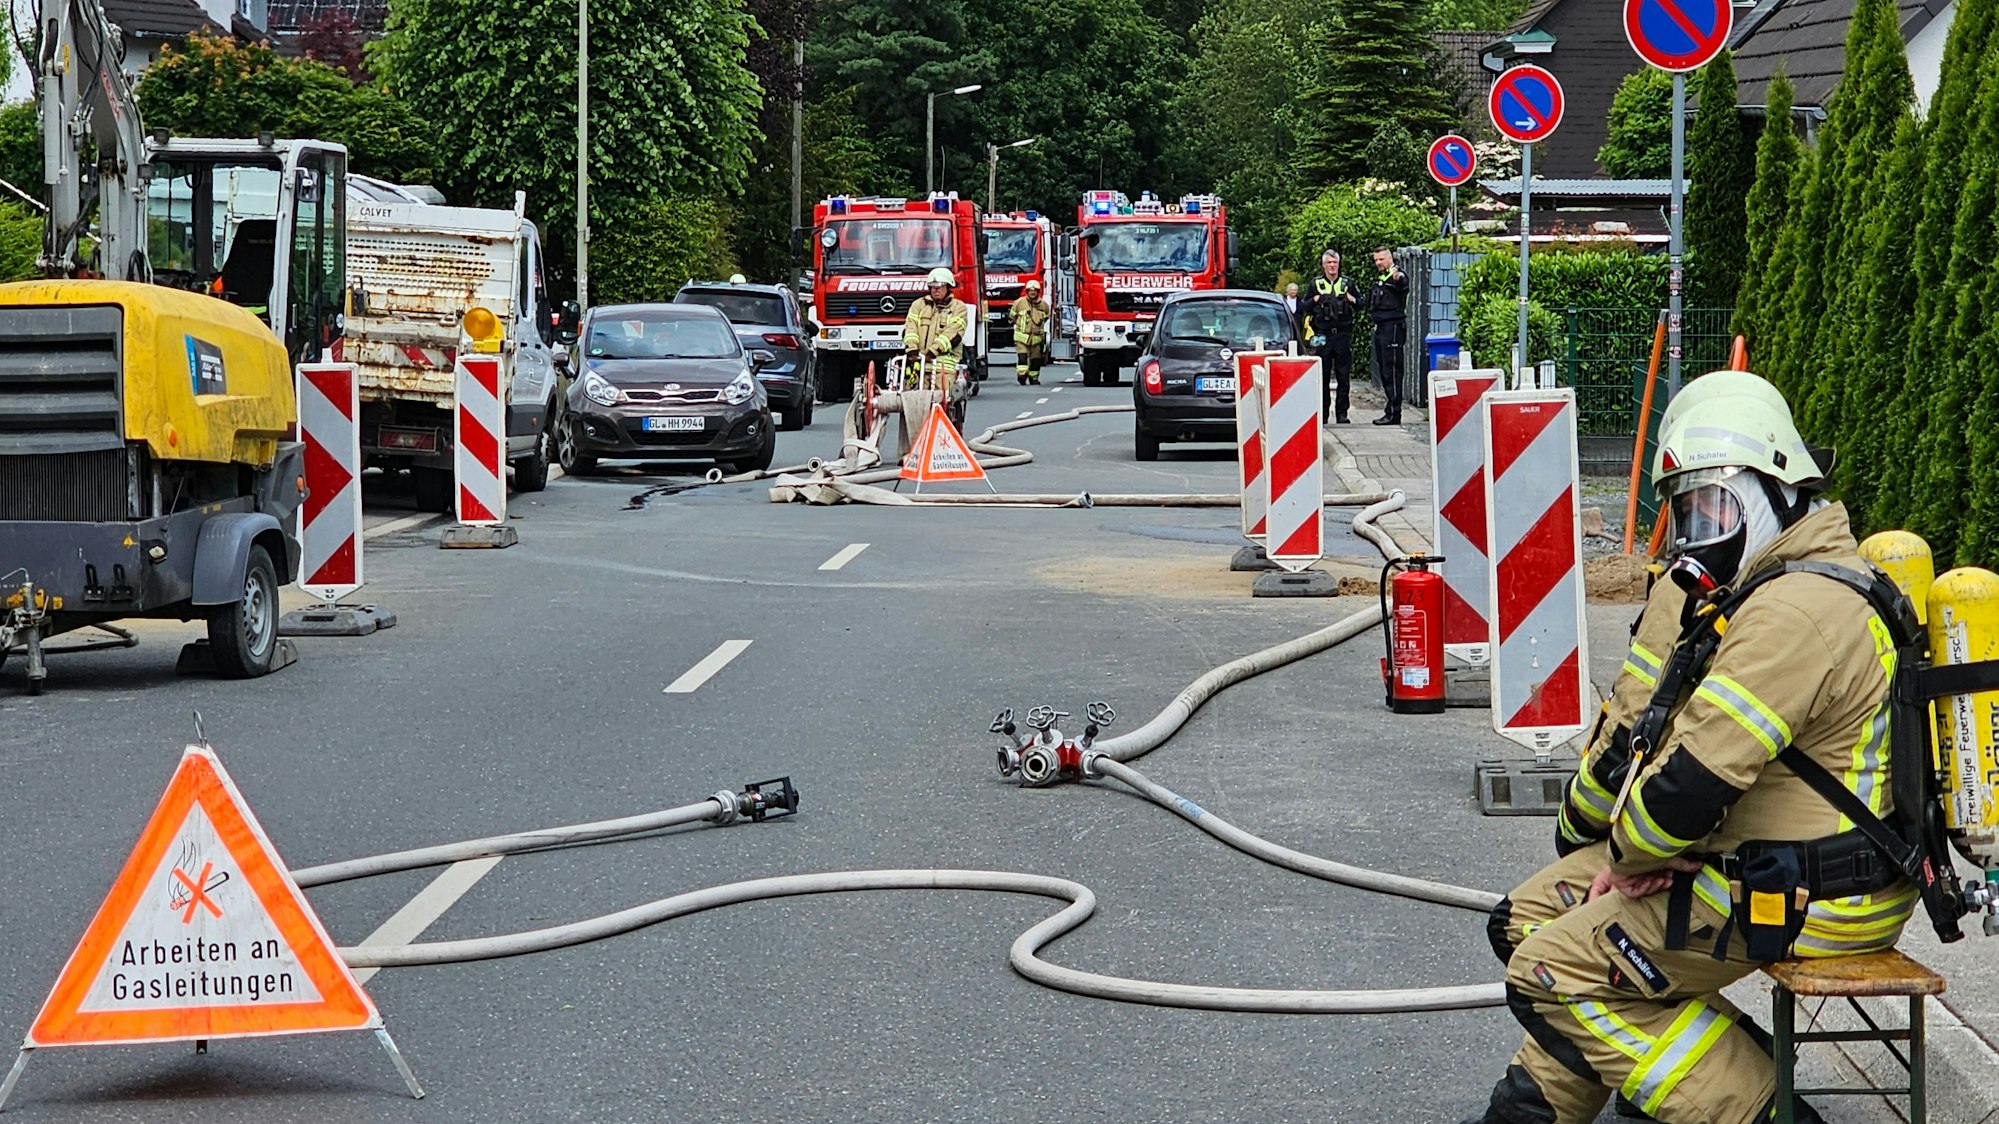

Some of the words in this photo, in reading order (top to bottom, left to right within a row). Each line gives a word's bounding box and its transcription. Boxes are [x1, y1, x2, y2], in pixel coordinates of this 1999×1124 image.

[360, 207, 392, 218] CALVET
[985, 275, 1018, 283] RWEHR
[1103, 276, 1194, 288] FEUERWEHR
[838, 278, 928, 292] FEUERWEH
[1133, 296, 1163, 304] MAN
[1203, 380, 1214, 389] GL
[1220, 380, 1231, 389] EA
[1519, 406, 1540, 414] SAUER
[649, 418, 661, 429] GL
[668, 418, 680, 429] HH
[681, 418, 704, 429] 9944
[1962, 758, 1979, 825] Freiwillige
[121, 936, 237, 966] Arbeiten
[251, 937, 280, 960] an
[1627, 948, 1656, 980] Schäfer
[112, 970, 293, 1001] Gasleitungen
